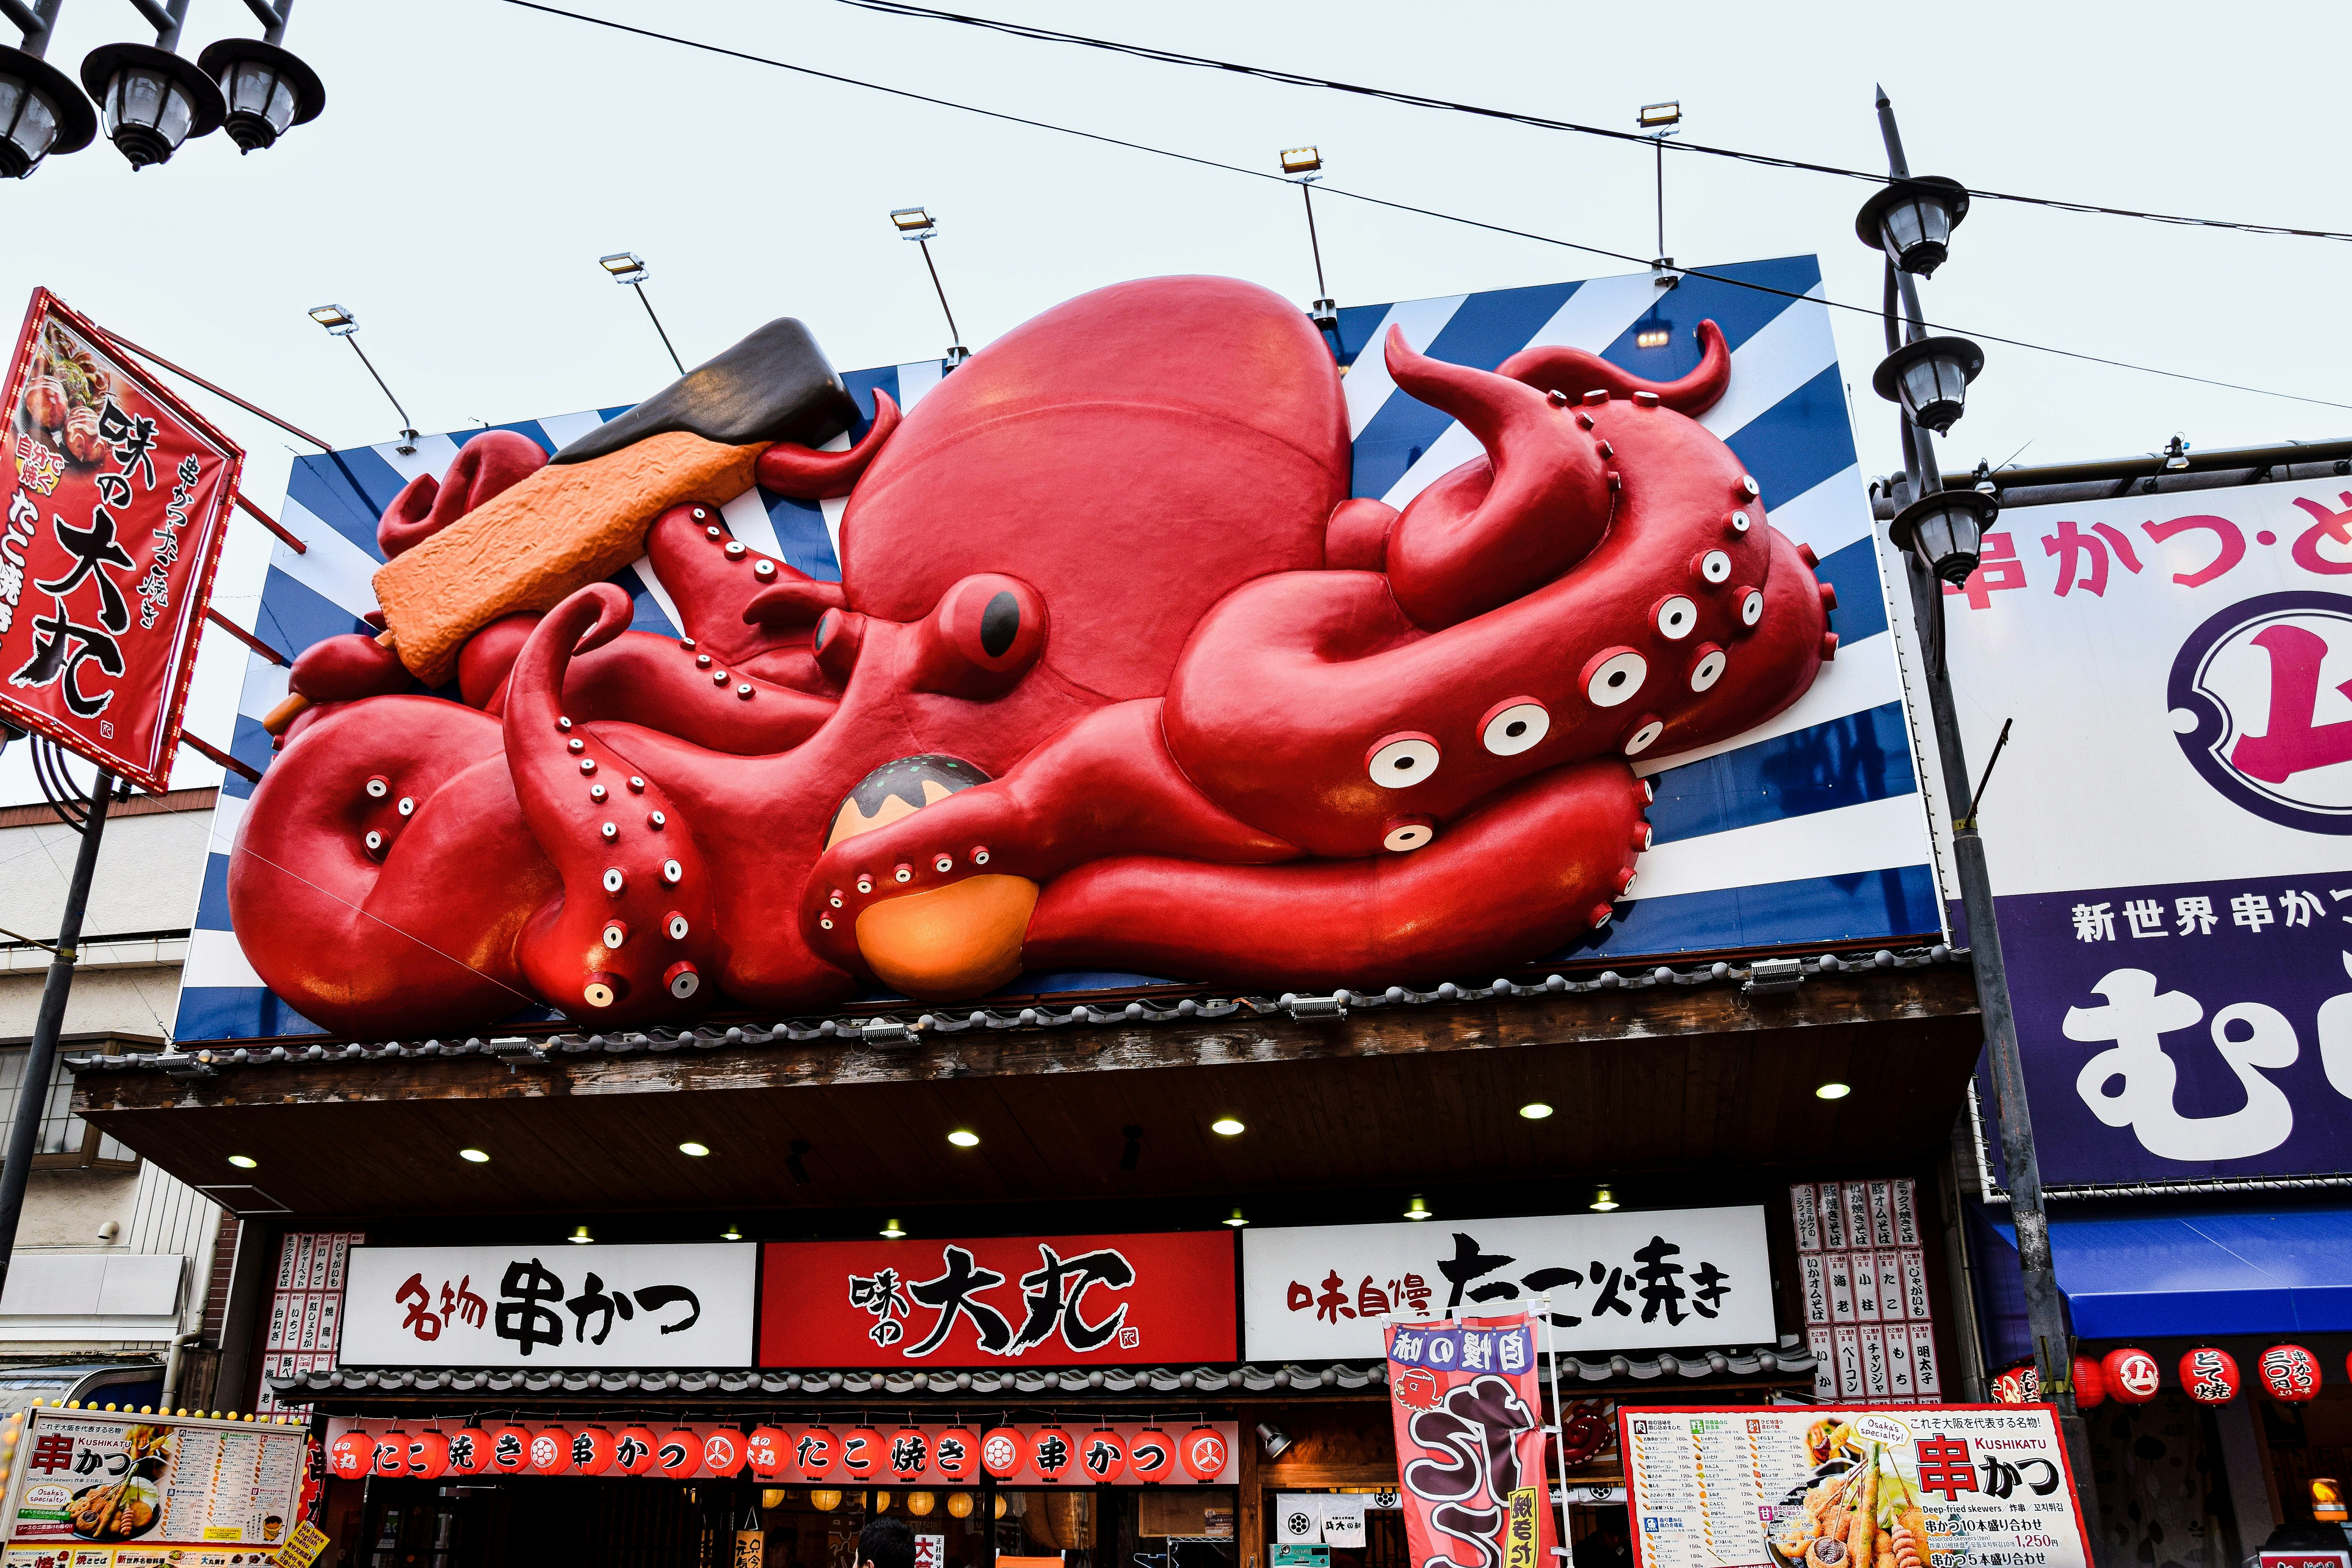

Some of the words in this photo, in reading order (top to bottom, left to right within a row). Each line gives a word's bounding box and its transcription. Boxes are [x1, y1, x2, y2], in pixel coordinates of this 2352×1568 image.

[1823, 1185, 1842, 1246] 豚焼きそば
[1849, 1183, 1868, 1245] いか焼きそば
[1871, 1183, 1890, 1245] 豚オムそば
[279, 1236, 294, 1287] ミックスオムそば
[314, 1248, 326, 1285] いちご
[330, 1242, 345, 1287] じゃがいも
[1806, 1258, 1824, 1321] いかオムそば
[1833, 1274, 1849, 1313] 海老
[1858, 1273, 1875, 1312] 小柱
[1883, 1272, 1898, 1310] たこ
[1908, 1266, 1924, 1316] じゃがいも
[271, 1308, 283, 1341] 白ねぎ
[287, 1308, 299, 1340] いちご
[303, 1302, 318, 1347] 紅しょうが
[321, 1306, 334, 1337] 焼鳥
[1816, 1350, 1831, 1388] いか
[1842, 1346, 1858, 1392] ベーコン
[1867, 1343, 1884, 1394] チャンジャ
[1893, 1347, 1907, 1385] もち
[1916, 1345, 1934, 1385] 明太子
[2193, 1351, 2232, 1401] どて焼
[2291, 1349, 2313, 1387] 串かつ
[751, 1435, 771, 1446] 味の
[1860, 1427, 1904, 1443] specialty!
[1867, 1419, 1899, 1433] Osaka's
[1910, 1417, 2042, 1429] これぞ大阪を代表する名物!
[572, 1432, 688, 1470] 串かつ
[796, 1435, 967, 1473] たこ焼き
[1034, 1435, 1169, 1475] 串かつ
[1975, 1437, 2047, 1450] KUSHIKATU
[1914, 1433, 2060, 1502] 串かつ
[30, 1495, 67, 1504] specialty!
[38, 1488, 64, 1497] Osaka's
[1923, 1504, 1966, 1514] Deep-fried
[293, 1535, 310, 1549] menu
[297, 1529, 318, 1547] English
[301, 1523, 310, 1534] We
[310, 1530, 325, 1544] have
